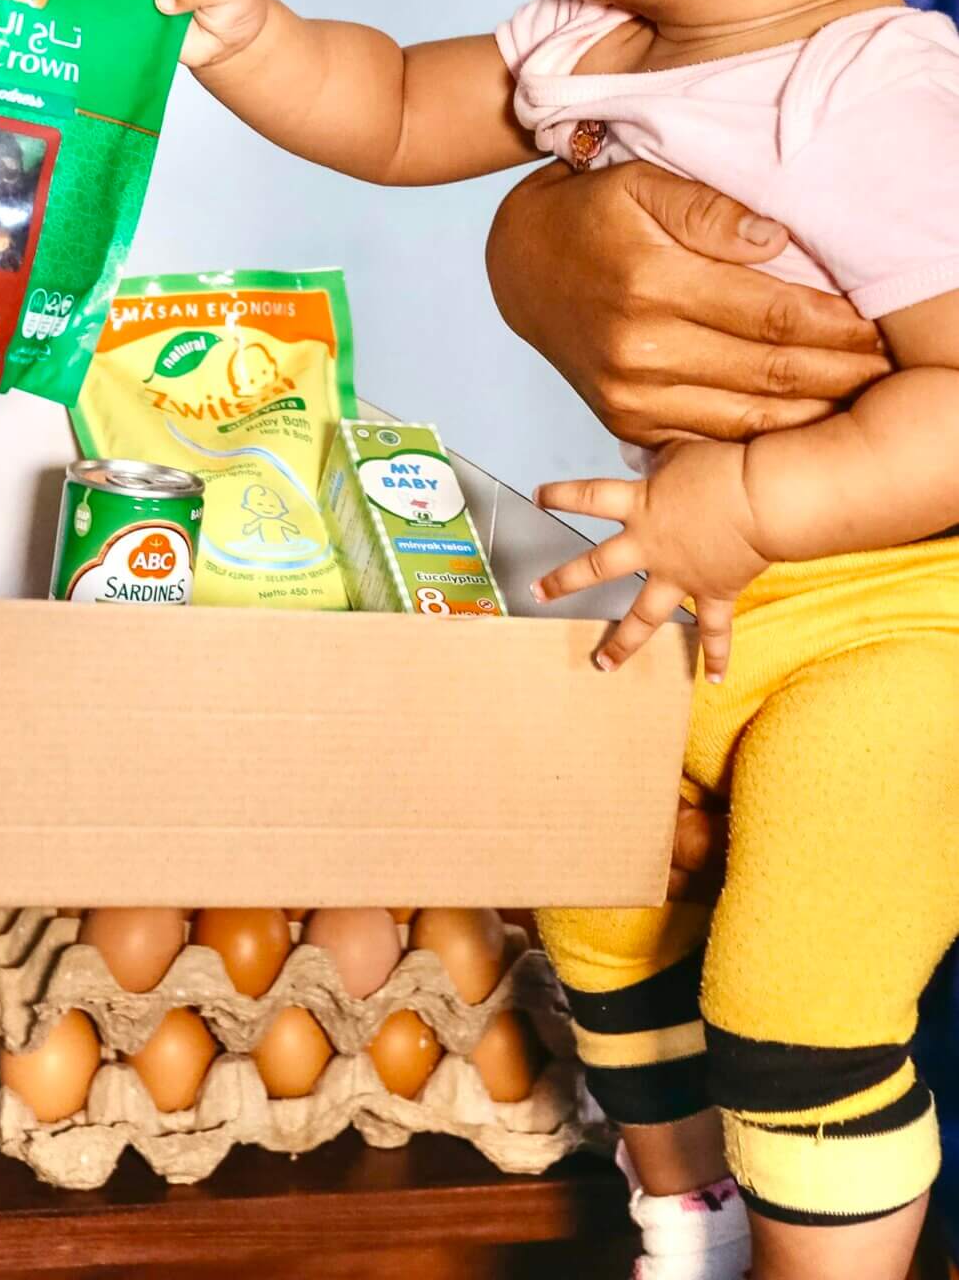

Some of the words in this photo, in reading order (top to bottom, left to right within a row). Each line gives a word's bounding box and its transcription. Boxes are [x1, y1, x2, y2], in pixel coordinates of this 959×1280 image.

[28, 19, 82, 54] تاج
[109, 301, 199, 324] EMASAN
[206, 300, 297, 322] EKONOMIS
[162, 335, 207, 369] natural
[282, 415, 312, 431] Bath
[390, 463, 422, 476] MY
[381, 476, 439, 491] BABY
[396, 540, 442, 552] minyak
[131, 552, 173, 571] ABC
[415, 572, 488, 586] Eucalyptus
[104, 576, 186, 603] SARDINES
[290, 587, 308, 596] 450
[416, 587, 452, 616] 8
